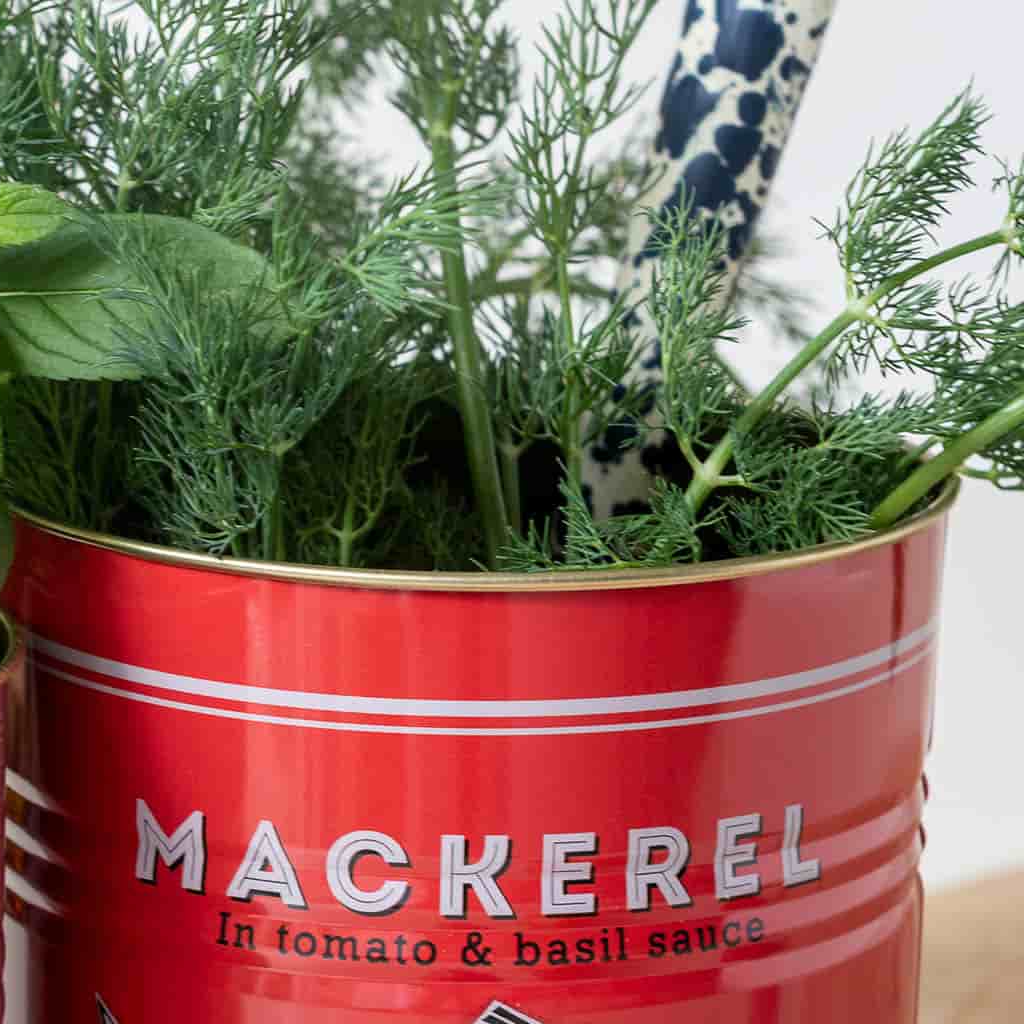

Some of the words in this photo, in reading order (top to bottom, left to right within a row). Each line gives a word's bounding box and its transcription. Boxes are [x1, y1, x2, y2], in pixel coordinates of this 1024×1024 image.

[135, 797, 822, 921] MACKEREL
[216, 911, 258, 953] In
[276, 922, 439, 967] tomato
[461, 931, 494, 967] &
[513, 924, 627, 968] basil
[646, 917, 767, 959] sauce
